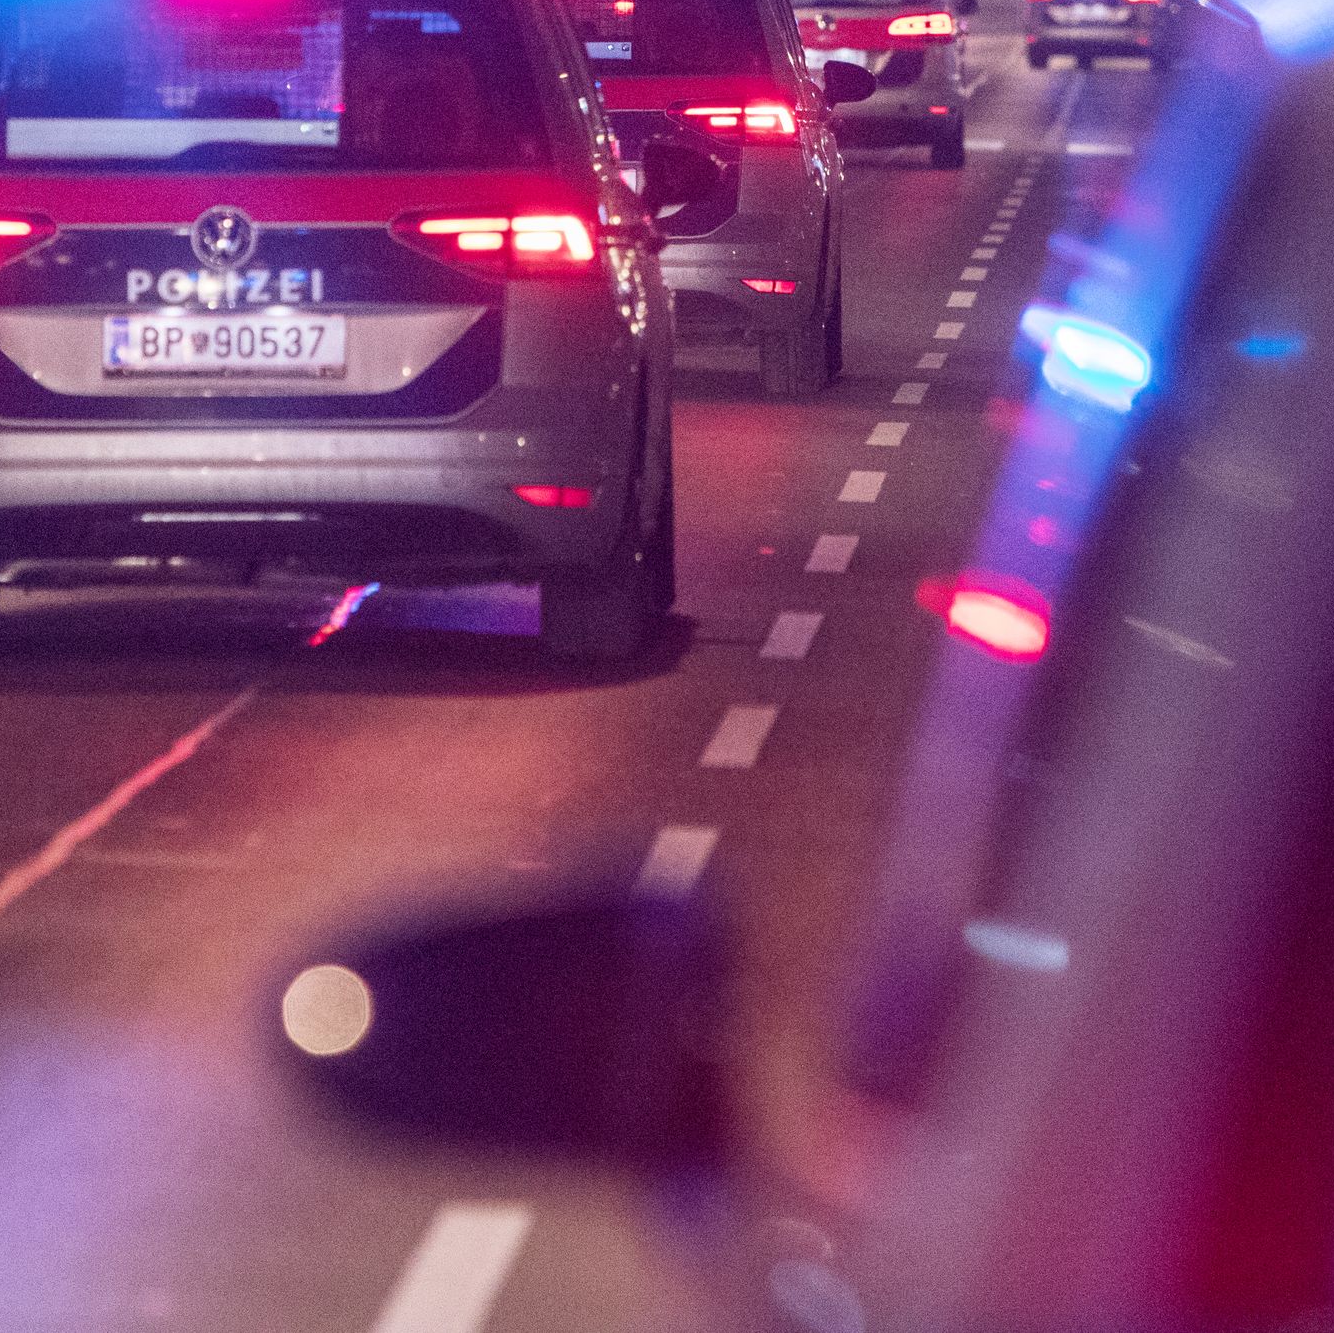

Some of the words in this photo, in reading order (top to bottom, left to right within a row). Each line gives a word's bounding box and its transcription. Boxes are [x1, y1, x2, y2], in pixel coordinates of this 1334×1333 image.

[126, 268, 324, 303] POLIZEI
[140, 325, 184, 359] BP
[214, 325, 327, 359] 90537
